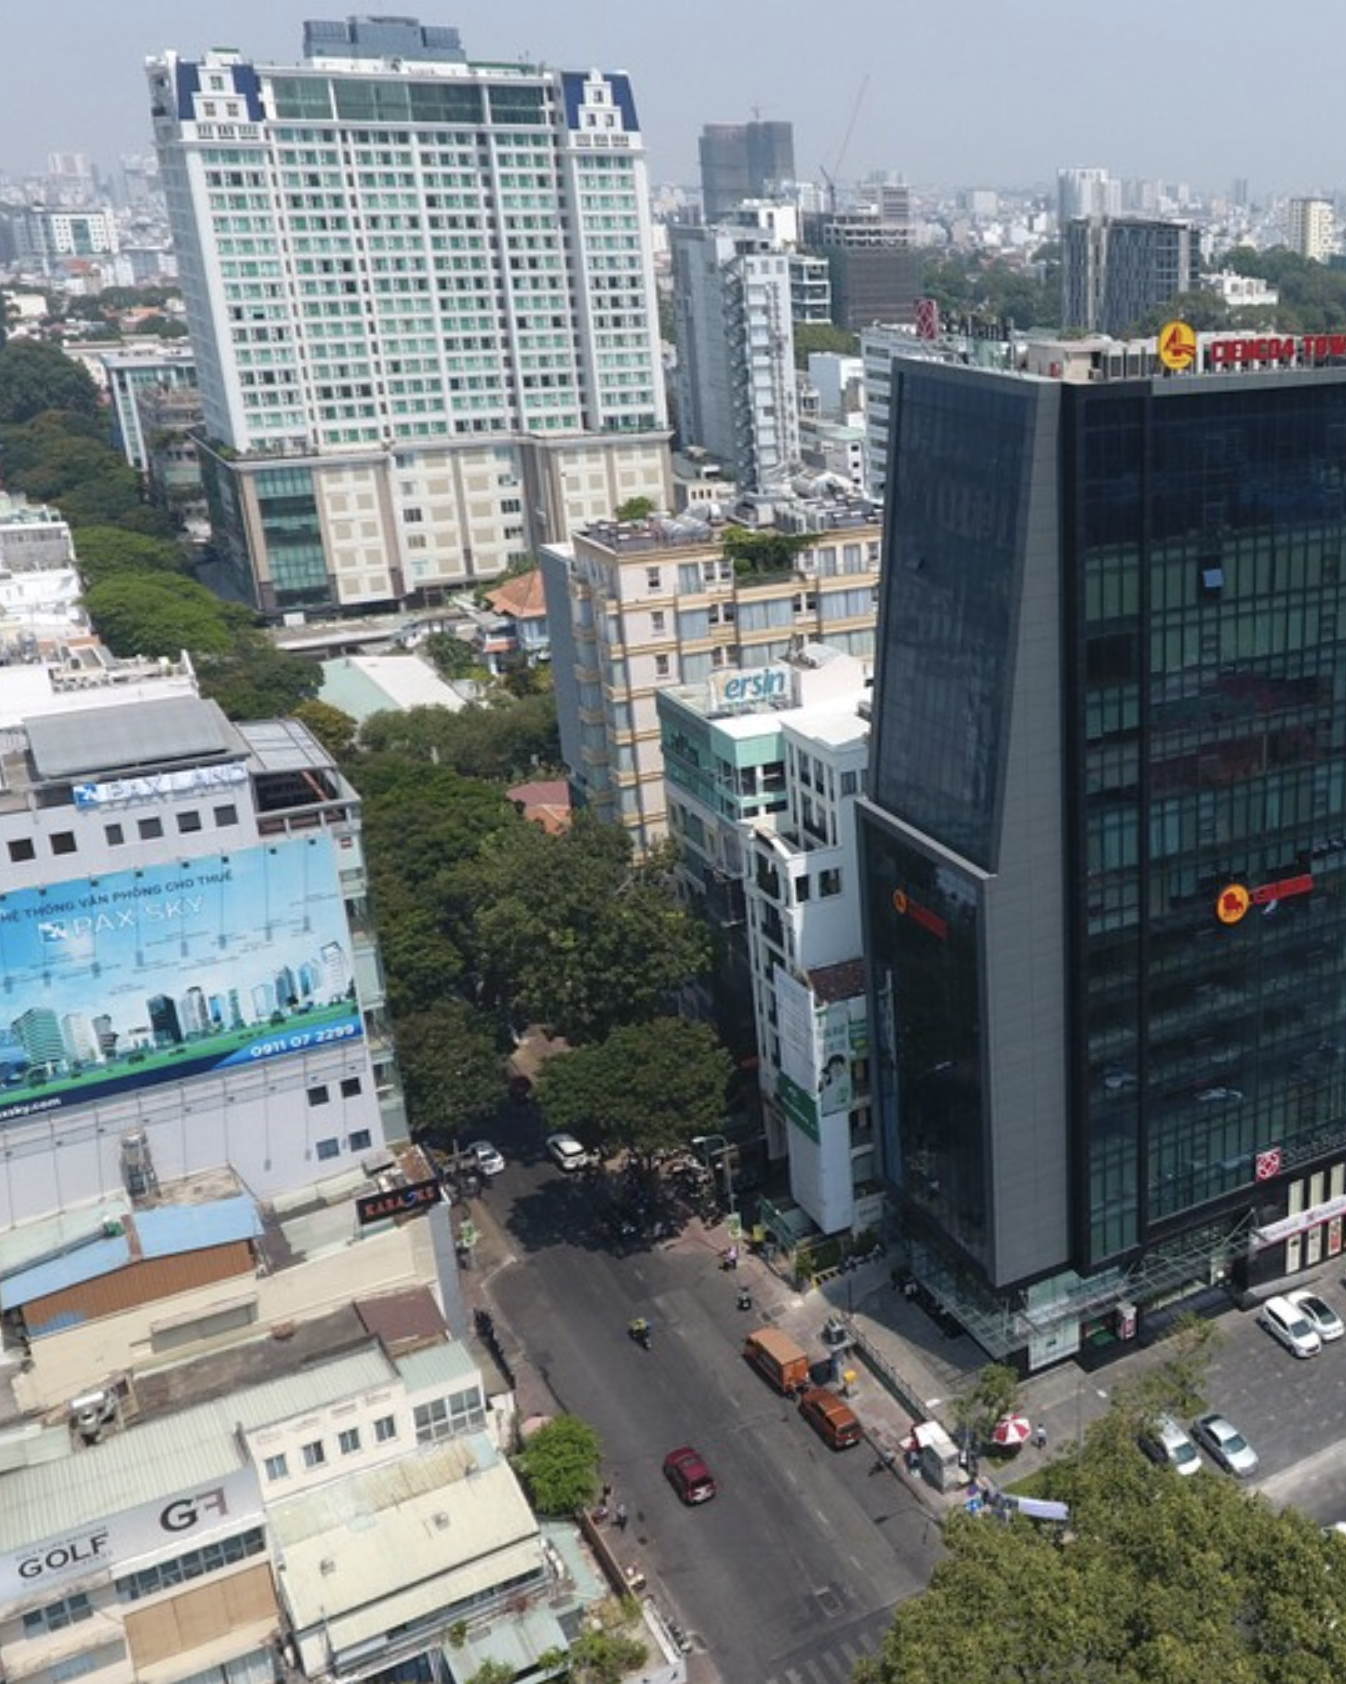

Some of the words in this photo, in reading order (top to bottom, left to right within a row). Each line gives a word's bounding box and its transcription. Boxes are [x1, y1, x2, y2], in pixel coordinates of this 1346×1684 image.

[165, 878, 195, 893] CHO
[73, 908, 136, 937] PAX
[145, 895, 202, 920] SKY
[250, 1038, 287, 1058] 0911
[290, 1033, 311, 1048] 07
[18, 1531, 109, 1579] GOLF
